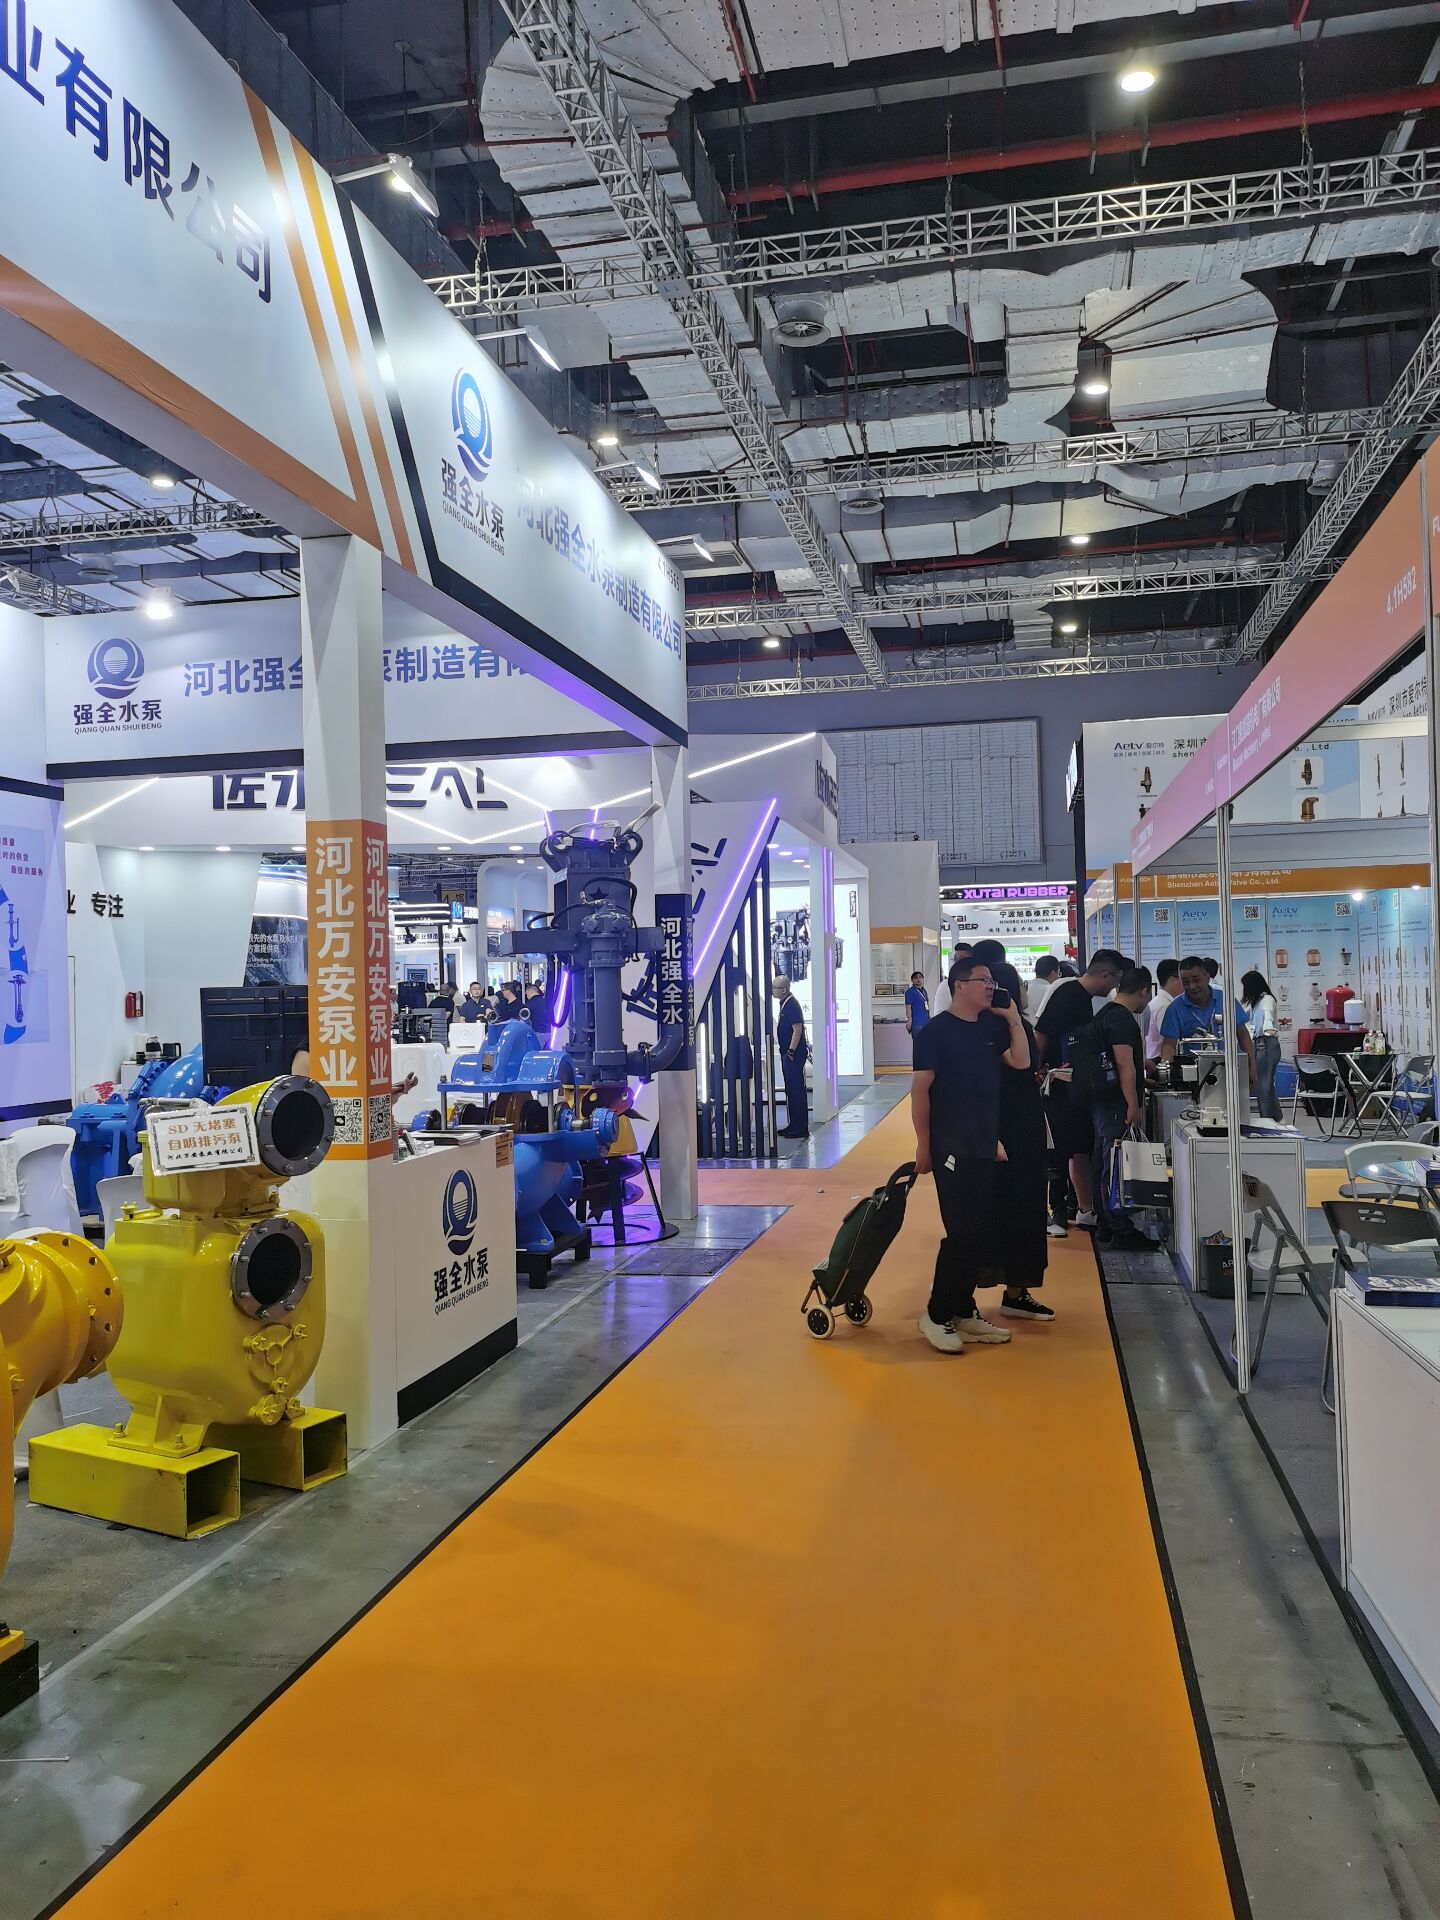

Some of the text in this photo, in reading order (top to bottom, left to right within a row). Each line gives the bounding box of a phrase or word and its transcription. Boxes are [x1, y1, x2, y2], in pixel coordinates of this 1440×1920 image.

[441, 458, 505, 542] 强全水泵
[442, 499, 505, 556] QIANG QUAN SHUI BENG
[515, 466, 682, 660] 河北强全水泵制造有限公司
[1386, 565, 1417, 616] 4.1H582
[74, 700, 162, 725] 强全水泵
[74, 721, 162, 734] QIANG QUAN SHUI BENG
[1007, 885, 1069, 898] RUBBER
[1167, 879, 1203, 889] Shenzhen
[91, 891, 124, 918] 专注
[315, 837, 358, 1087] 河北万安泵业
[366, 836, 389, 1086] 河北万安泵业
[167, 1132, 242, 1151] 自吸排污泵
[168, 1117, 237, 1135] SD 无堵塞
[167, 1146, 243, 1161] 河北万安泵业有限公司
[433, 1247, 489, 1303] 强全水泵
[434, 1278, 489, 1316] QIANG QUAN SHUI BENG
